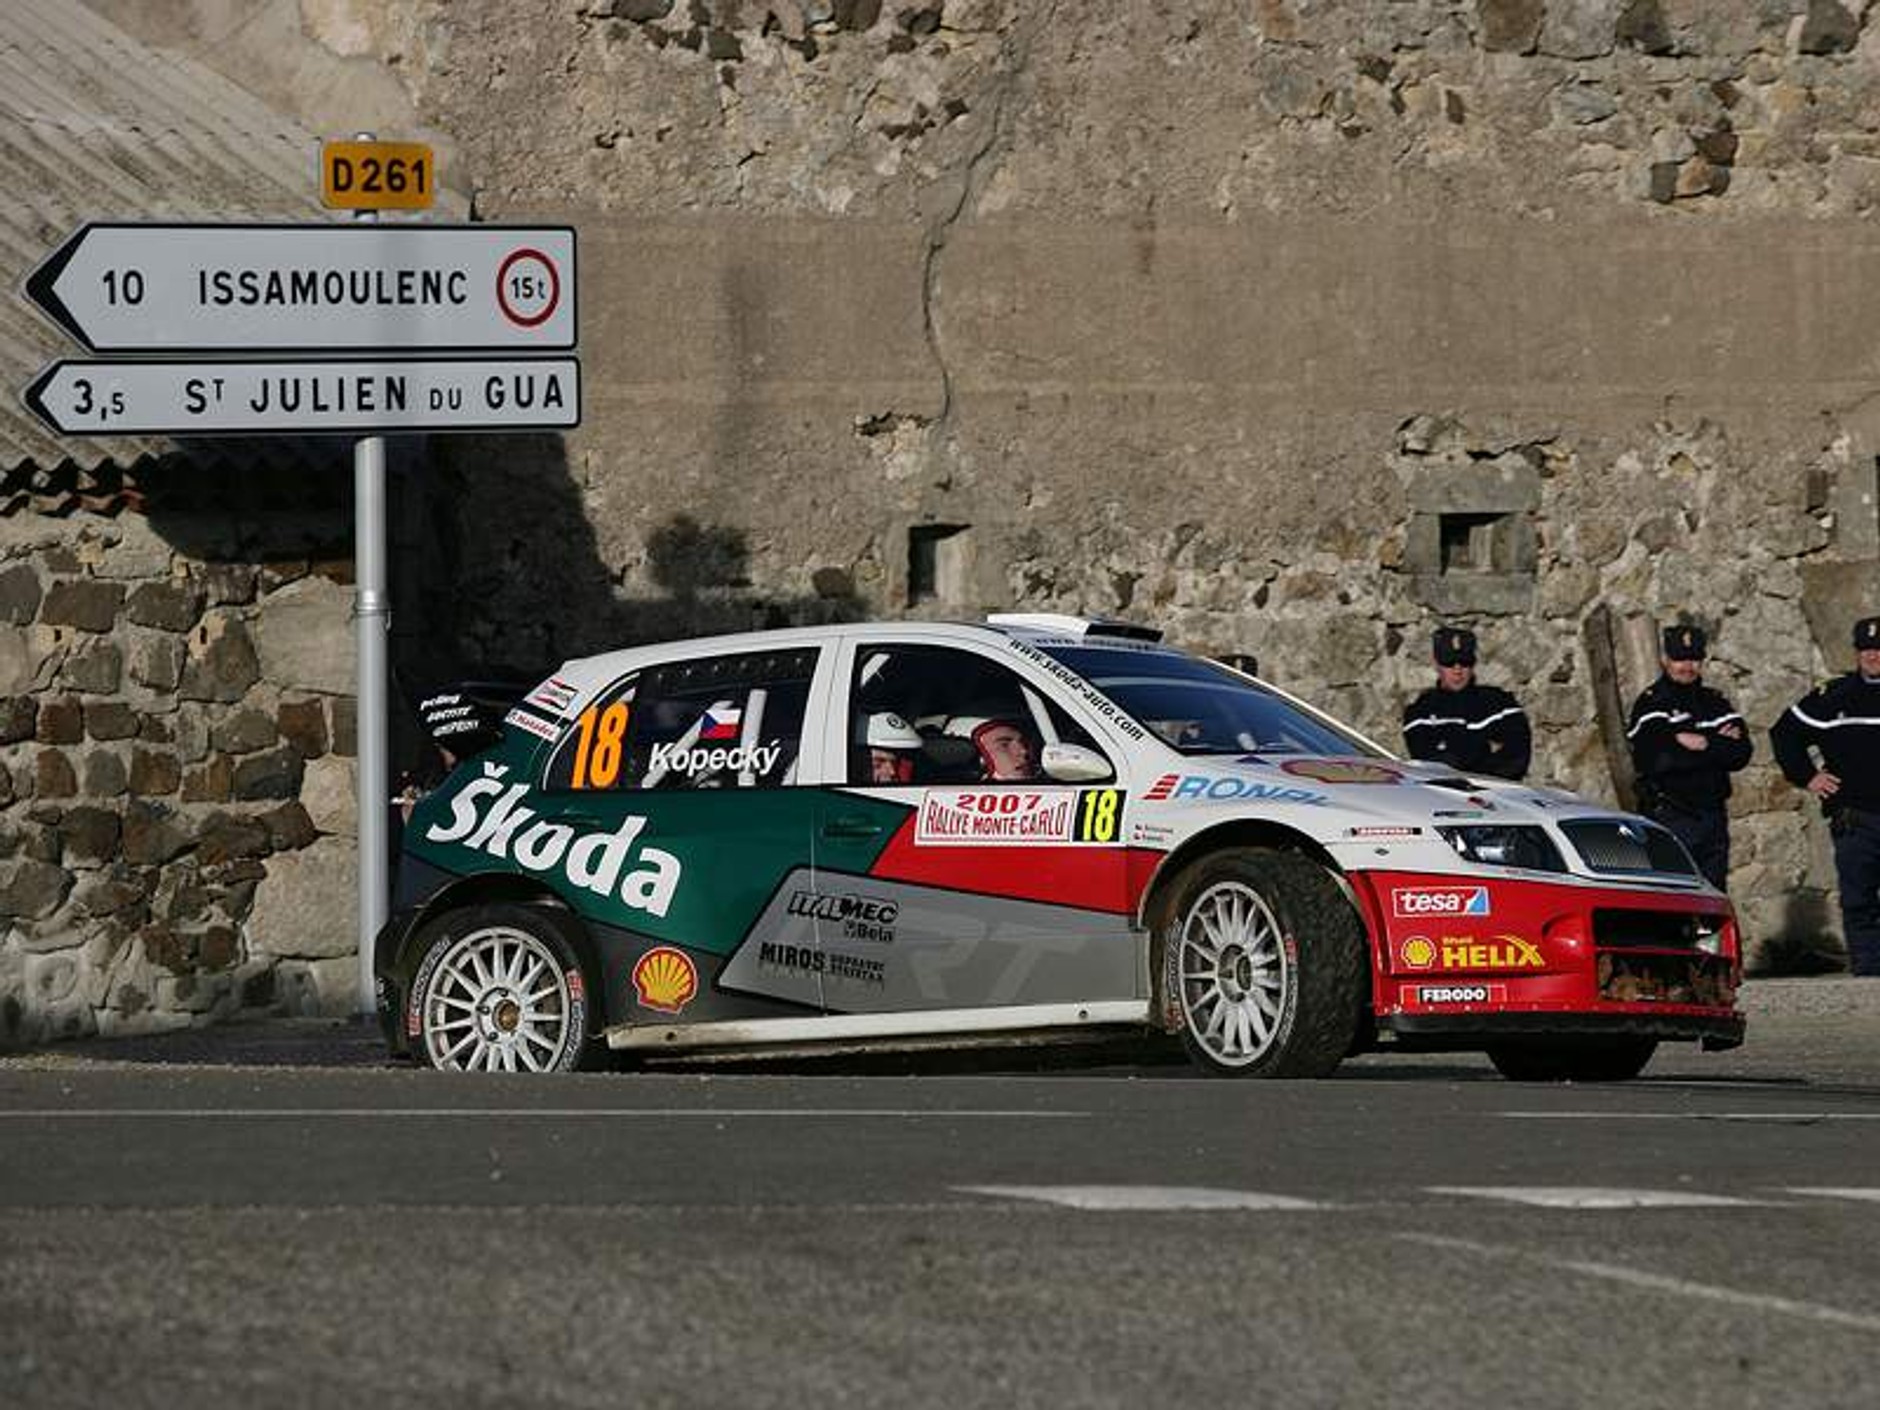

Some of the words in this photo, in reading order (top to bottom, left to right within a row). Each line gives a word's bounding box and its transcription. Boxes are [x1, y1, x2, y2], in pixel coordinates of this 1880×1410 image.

[332, 157, 426, 194] D261
[102, 270, 145, 304] 10
[199, 269, 468, 305] ISSAMOULENC
[73, 379, 126, 420] 3,5
[250, 376, 406, 412] JULIEN
[430, 387, 462, 411] DU
[485, 374, 563, 410] GUA
[571, 701, 629, 789] 18
[649, 739, 782, 777] Kopecký
[925, 801, 969, 836] RALLYE
[956, 794, 1042, 814] 2007
[1083, 790, 1118, 841] 18
[425, 761, 683, 918] Škoda
[1401, 893, 1461, 913] tesa
[760, 942, 826, 972] MIROS
[1442, 940, 1546, 968] HELIX
[1422, 988, 1487, 1002] FERODO
